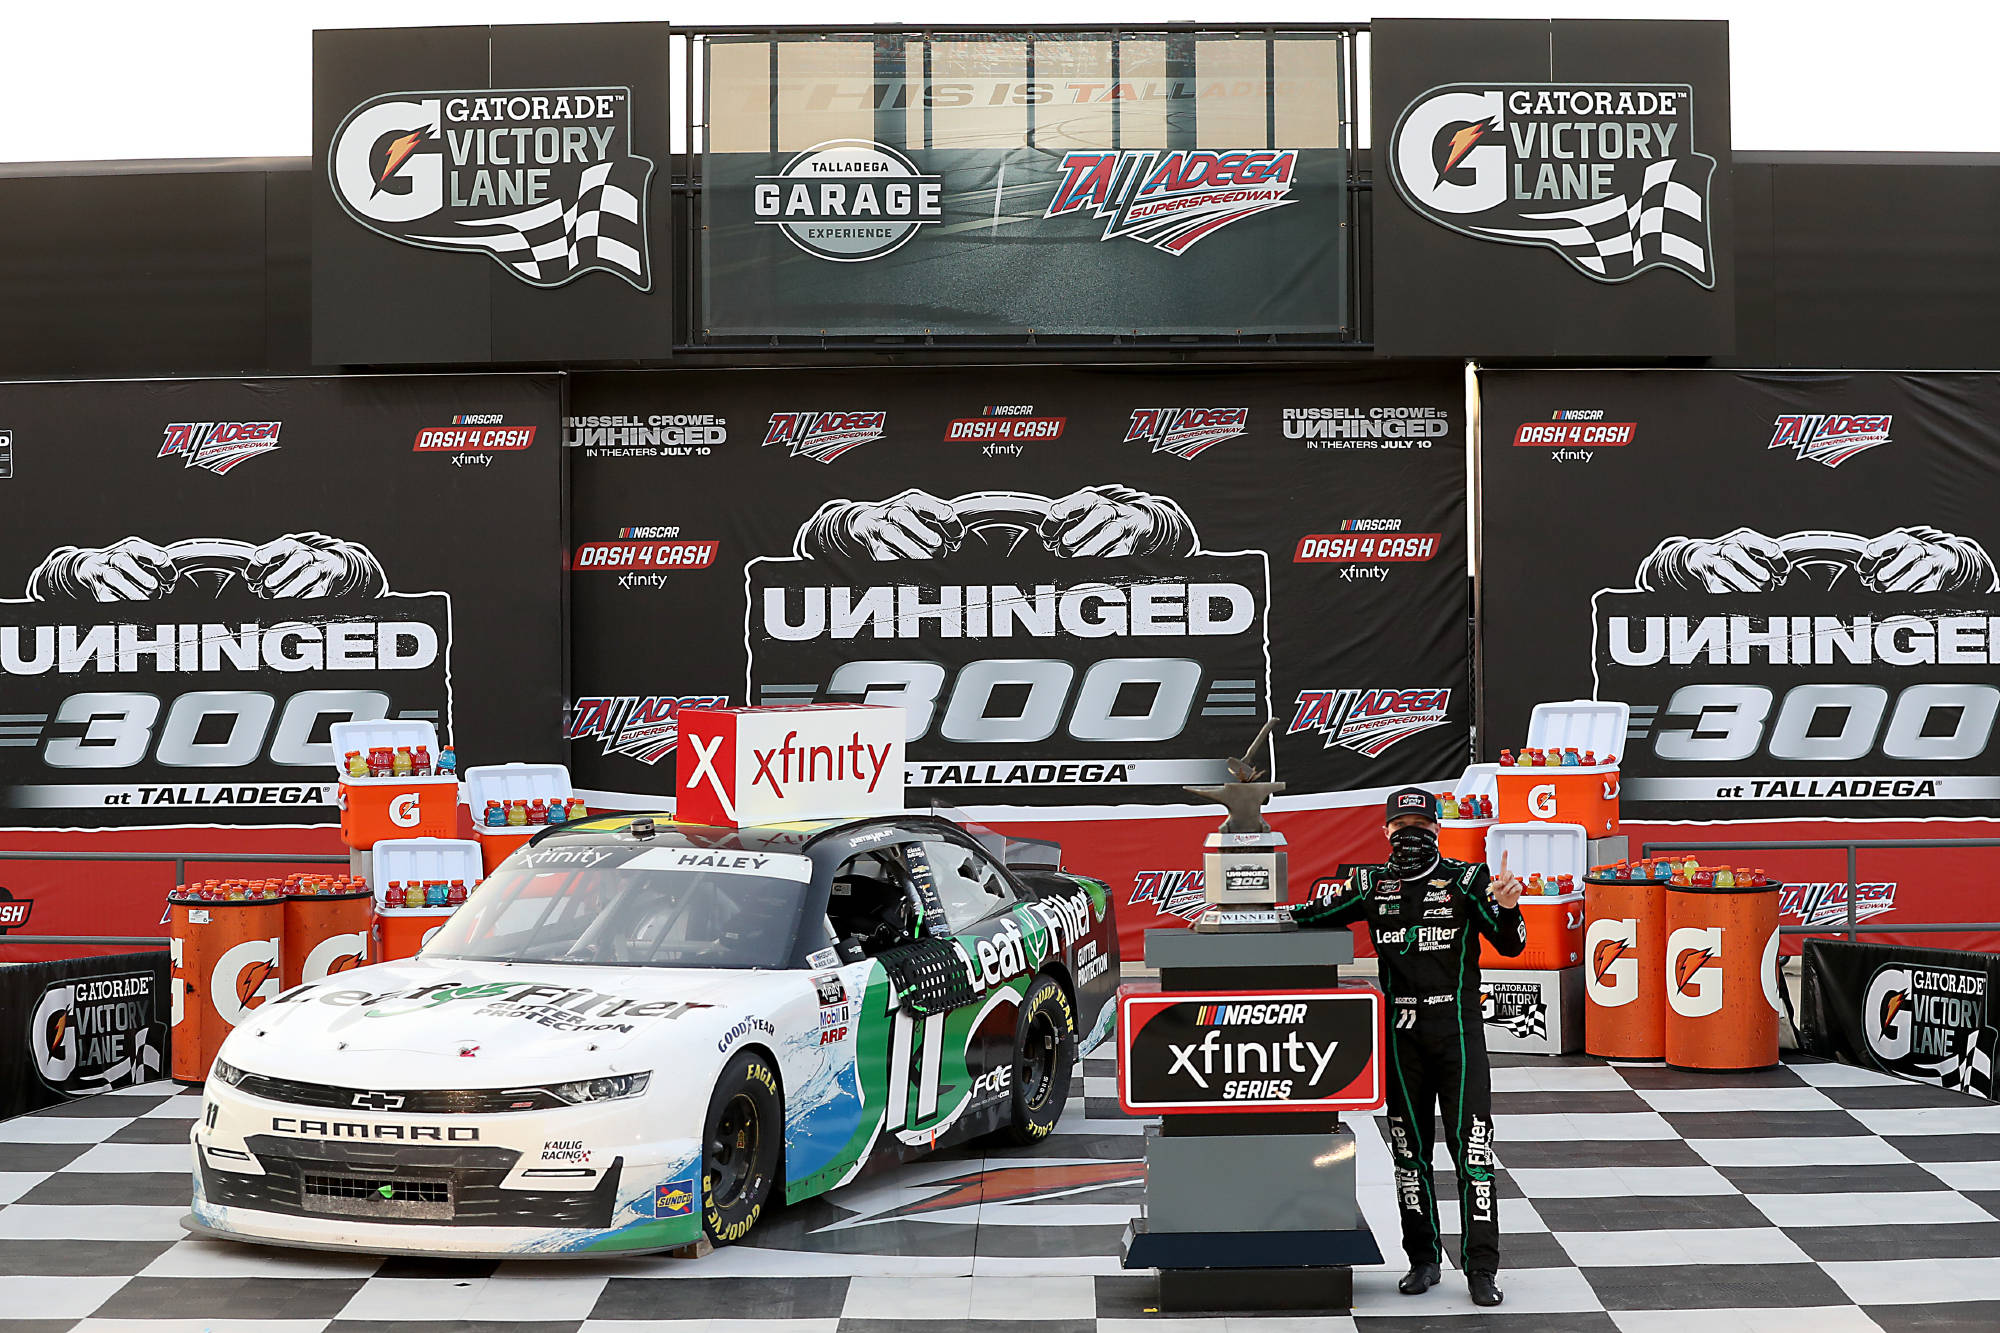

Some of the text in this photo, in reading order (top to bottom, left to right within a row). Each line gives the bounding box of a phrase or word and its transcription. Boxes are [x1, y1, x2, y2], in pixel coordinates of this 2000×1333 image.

[445, 96, 616, 121] GATORADE
[1508, 91, 1678, 117] GATORADE
[446, 126, 616, 166] VICTORY
[1509, 121, 1679, 160] VICTORY
[811, 162, 889, 173] TALLADEGA
[450, 168, 550, 207] LANE
[1514, 163, 1614, 201] LANE
[755, 182, 942, 217] GARAGE
[1044, 150, 1298, 241] TALLADEGA
[1129, 188, 1288, 220] SUPERSPEEDWAY
[808, 227, 892, 240] EXPERIENCE
[463, 414, 503, 425] NASCAR
[648, 415, 714, 426] CROWE
[994, 405, 1033, 416] NASCAR
[1283, 408, 1365, 420] RUSSELL
[1369, 407, 1435, 419] CROWE
[1564, 410, 1604, 420] NASCAR
[419, 428, 531, 448] DASH 4 CASH
[762, 411, 886, 457] TALLADEGA
[803, 430, 880, 448] SUPERSPEEDWAY
[950, 420, 1060, 438] DASH 4 CASH
[1123, 407, 1248, 457] TALLADEGA
[1165, 426, 1242, 444] SUPERSPEEDWAY
[1520, 426, 1631, 444] DASH 4 CASH
[1768, 414, 1893, 461] TALLADEGA
[157, 422, 282, 468] TALLADEGA
[200, 442, 275, 458] SUPERSPEEDWAY
[600, 448, 657, 457] THEATERS
[660, 447, 692, 456] JULY
[695, 447, 711, 456] 10
[982, 443, 1023, 457] xfinity
[1307, 440, 1432, 449] IN THEATERS JULY 10
[1809, 434, 1886, 450] SUPERSPEEDWAY
[451, 453, 494, 467] xfinity
[1552, 448, 1593, 463] xfinity
[634, 526, 680, 538] NASCAR
[1355, 519, 1401, 531] NASCAR
[579, 545, 711, 566] DASH 4 CASH
[1301, 537, 1433, 559] DASH 4 CASH
[618, 572, 667, 589] xfinity
[1339, 565, 1389, 582] xfinity
[825, 657, 1202, 744] 300
[1286, 688, 1452, 748] TALLADEGA
[1341, 714, 1442, 735] SUPERSPEEDWAY
[1653, 684, 2000, 762] 300
[42, 690, 391, 768] 300
[752, 730, 892, 799] xfinity
[920, 764, 1131, 785] TALLADEGA
[103, 786, 325, 806] at TALLADEGA
[1716, 781, 1937, 799] at TALLADEGA
[517, 848, 613, 868] xfinity
[677, 855, 769, 870] HALEY
[1231, 878, 1264, 886] 300
[1077, 940, 1096, 964] GUTTER
[1077, 953, 1108, 988] PROTECTION
[76, 976, 150, 1002] GATORADE
[1494, 983, 1539, 992] GATORADE
[1913, 970, 1984, 997] GATORADE
[1494, 993, 1538, 1005] VICTORY
[76, 1000, 147, 1036] VICTORY
[820, 1008, 841, 1026] Mobil
[842, 1006, 849, 1020] 1
[1222, 1003, 1308, 1026] NASCAR
[1395, 1009, 1417, 1029] 11
[1495, 1005, 1521, 1016] LANE
[1913, 994, 1981, 1028] VICTORY
[717, 1014, 776, 1054] GOODYEAR
[820, 1027, 848, 1045] ARP
[1913, 1026, 1953, 1057] LANE
[77, 1034, 125, 1067] LANE
[1167, 1030, 1339, 1089] xfinity
[746, 1064, 777, 1096] EAGLE
[1223, 1080, 1293, 1100] SERIES
[206, 1102, 219, 1129] 11
[273, 1117, 479, 1142] CAMARO
[1026, 1119, 1053, 1137] EAGLE
[541, 1151, 581, 1160] RACING
[544, 1141, 582, 1150] KAULIG
[657, 1193, 693, 1207] SUNOCO
